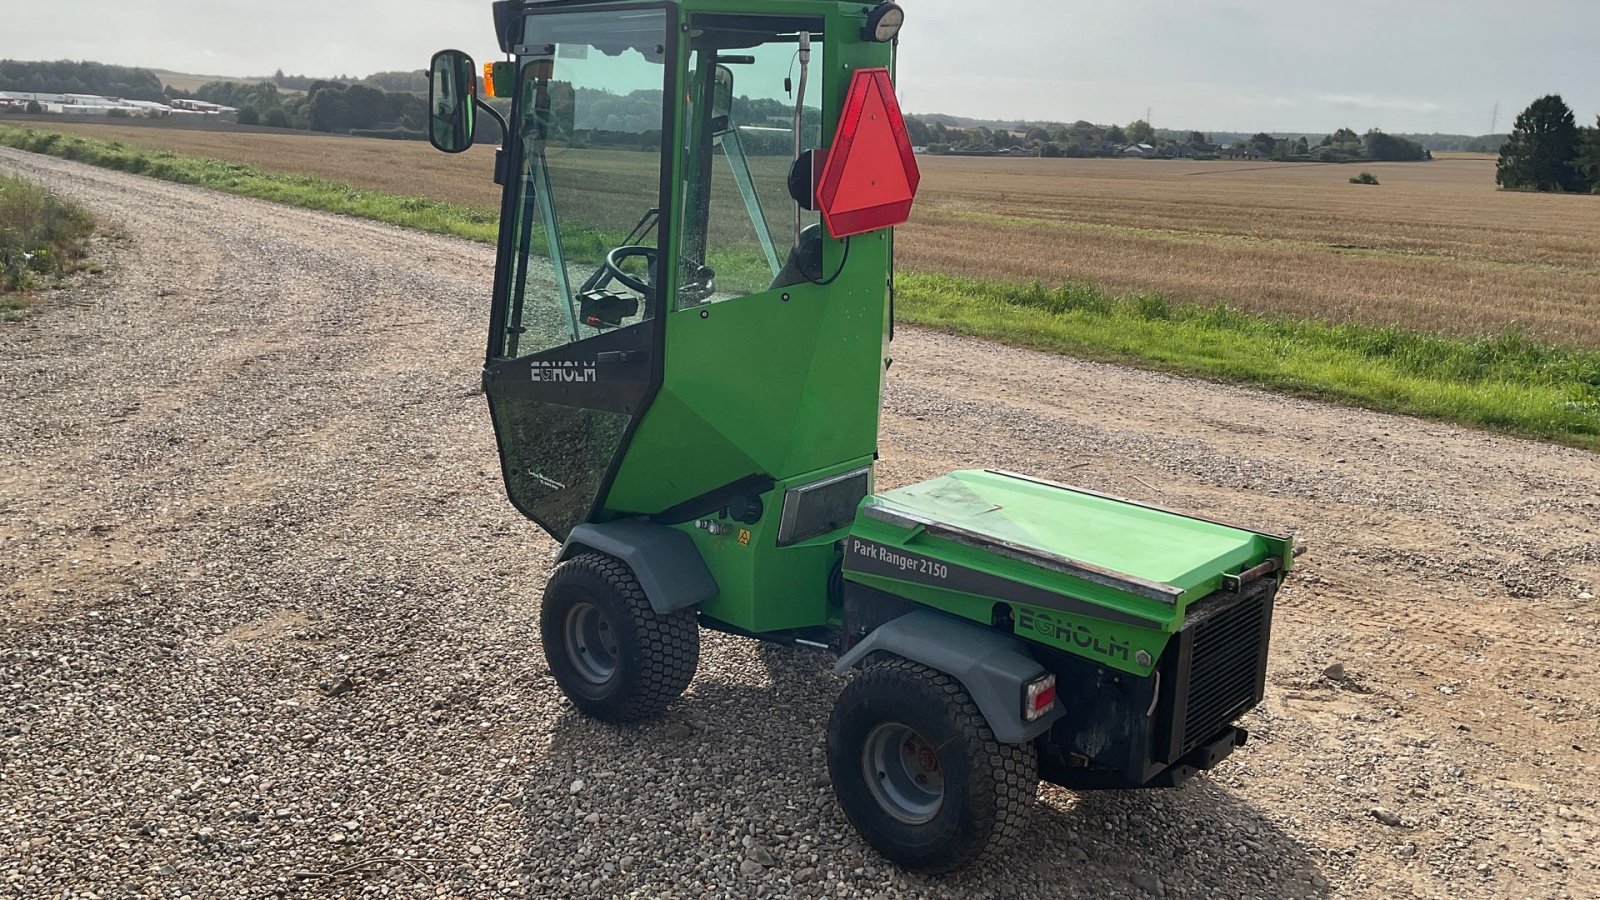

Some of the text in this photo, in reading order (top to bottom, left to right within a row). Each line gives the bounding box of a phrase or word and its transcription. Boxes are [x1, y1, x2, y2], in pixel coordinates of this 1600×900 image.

[531, 361, 596, 382] EGHOLM
[854, 540, 948, 579] Park Ranger 2150
[1020, 608, 1129, 661] EGHOLM
